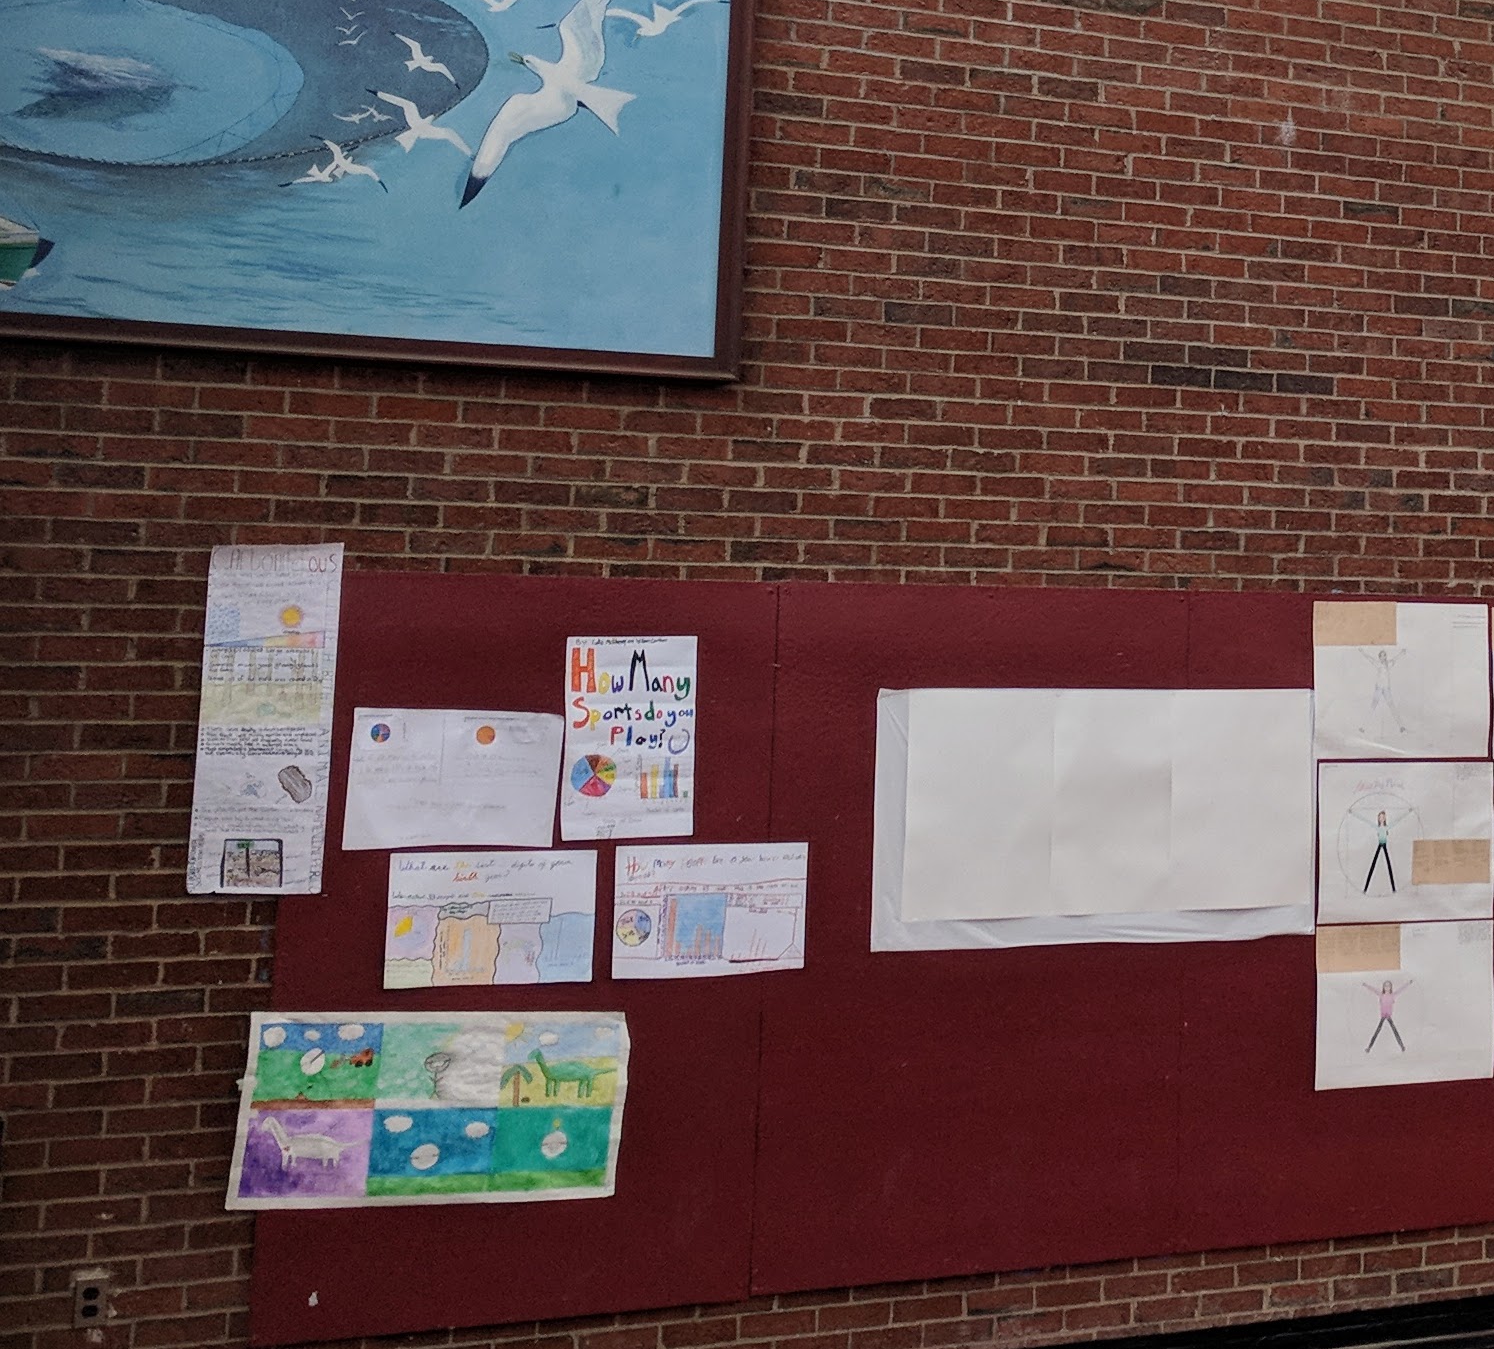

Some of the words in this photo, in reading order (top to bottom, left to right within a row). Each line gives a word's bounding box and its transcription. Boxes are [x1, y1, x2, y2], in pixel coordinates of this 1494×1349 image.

[571, 647, 625, 694] How
[628, 649, 691, 701] Many
[610, 725, 666, 749] Play?
